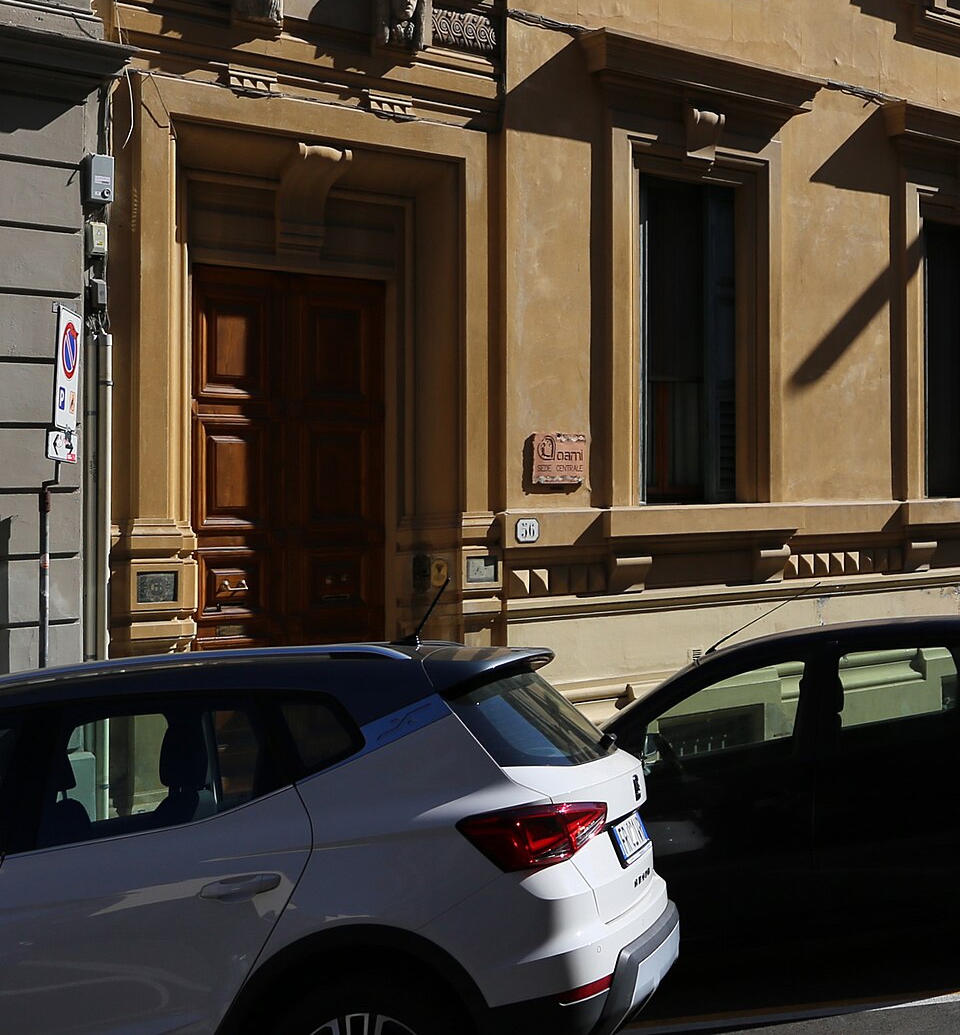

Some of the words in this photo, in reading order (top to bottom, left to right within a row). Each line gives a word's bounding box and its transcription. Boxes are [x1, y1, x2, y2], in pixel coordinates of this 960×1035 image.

[556, 450, 583, 461] oami
[537, 464, 552, 472] SEDE
[556, 464, 583, 472] CENTRALE
[521, 522, 536, 539] 56
